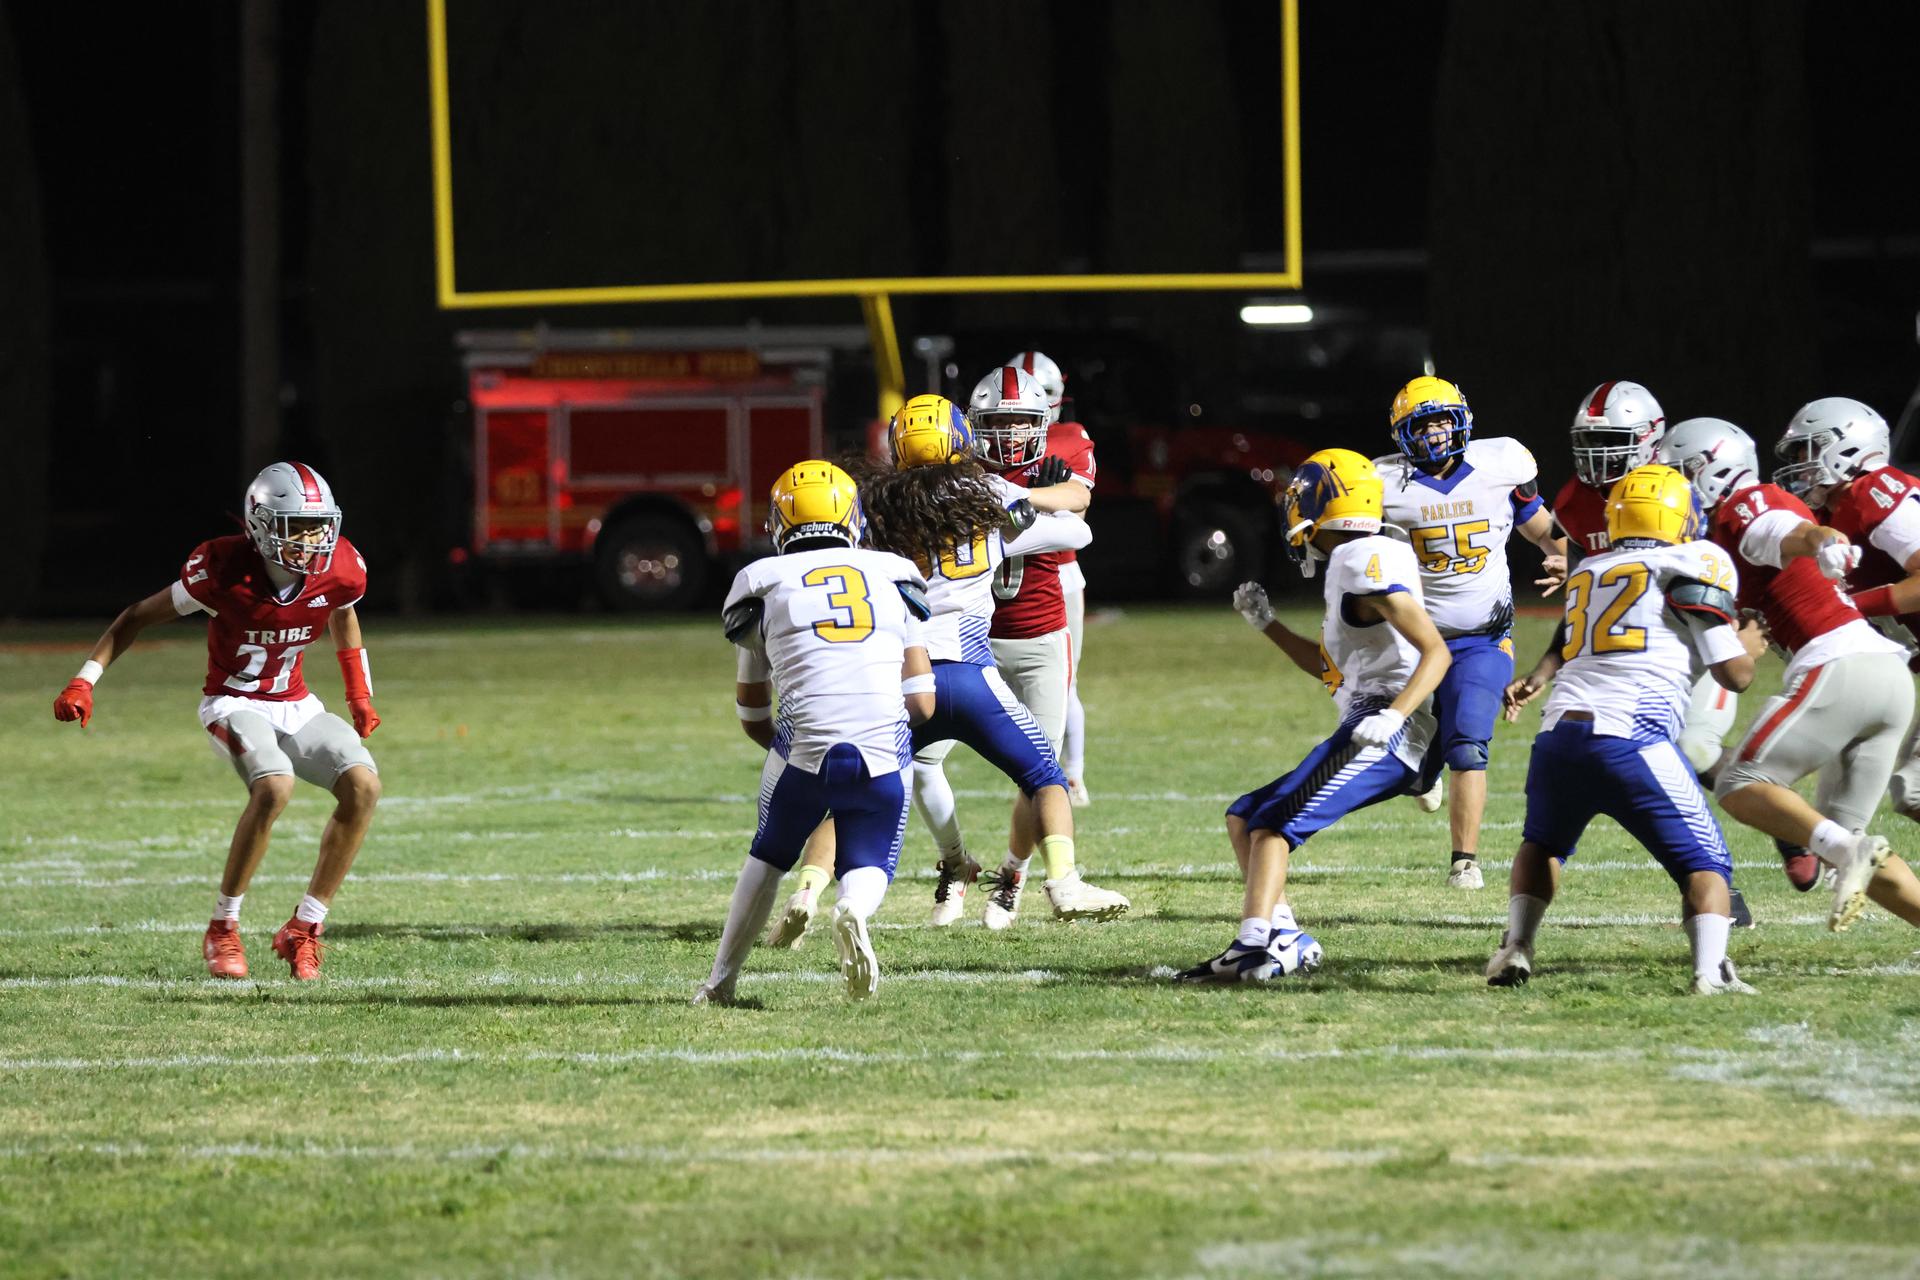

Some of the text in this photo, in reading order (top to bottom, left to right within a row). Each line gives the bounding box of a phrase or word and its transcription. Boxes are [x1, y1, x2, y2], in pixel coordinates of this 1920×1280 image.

[1869, 473, 1906, 509] 44
[800, 522, 834, 533] schutt
[1420, 499, 1474, 522] PARLIER
[1409, 519, 1491, 575] 55
[1365, 554, 1383, 583] 4
[1699, 553, 1734, 590] 32
[801, 565, 876, 643] 3
[1561, 560, 1653, 662] 32
[244, 625, 313, 645] TRIBE
[223, 643, 306, 694] 21
